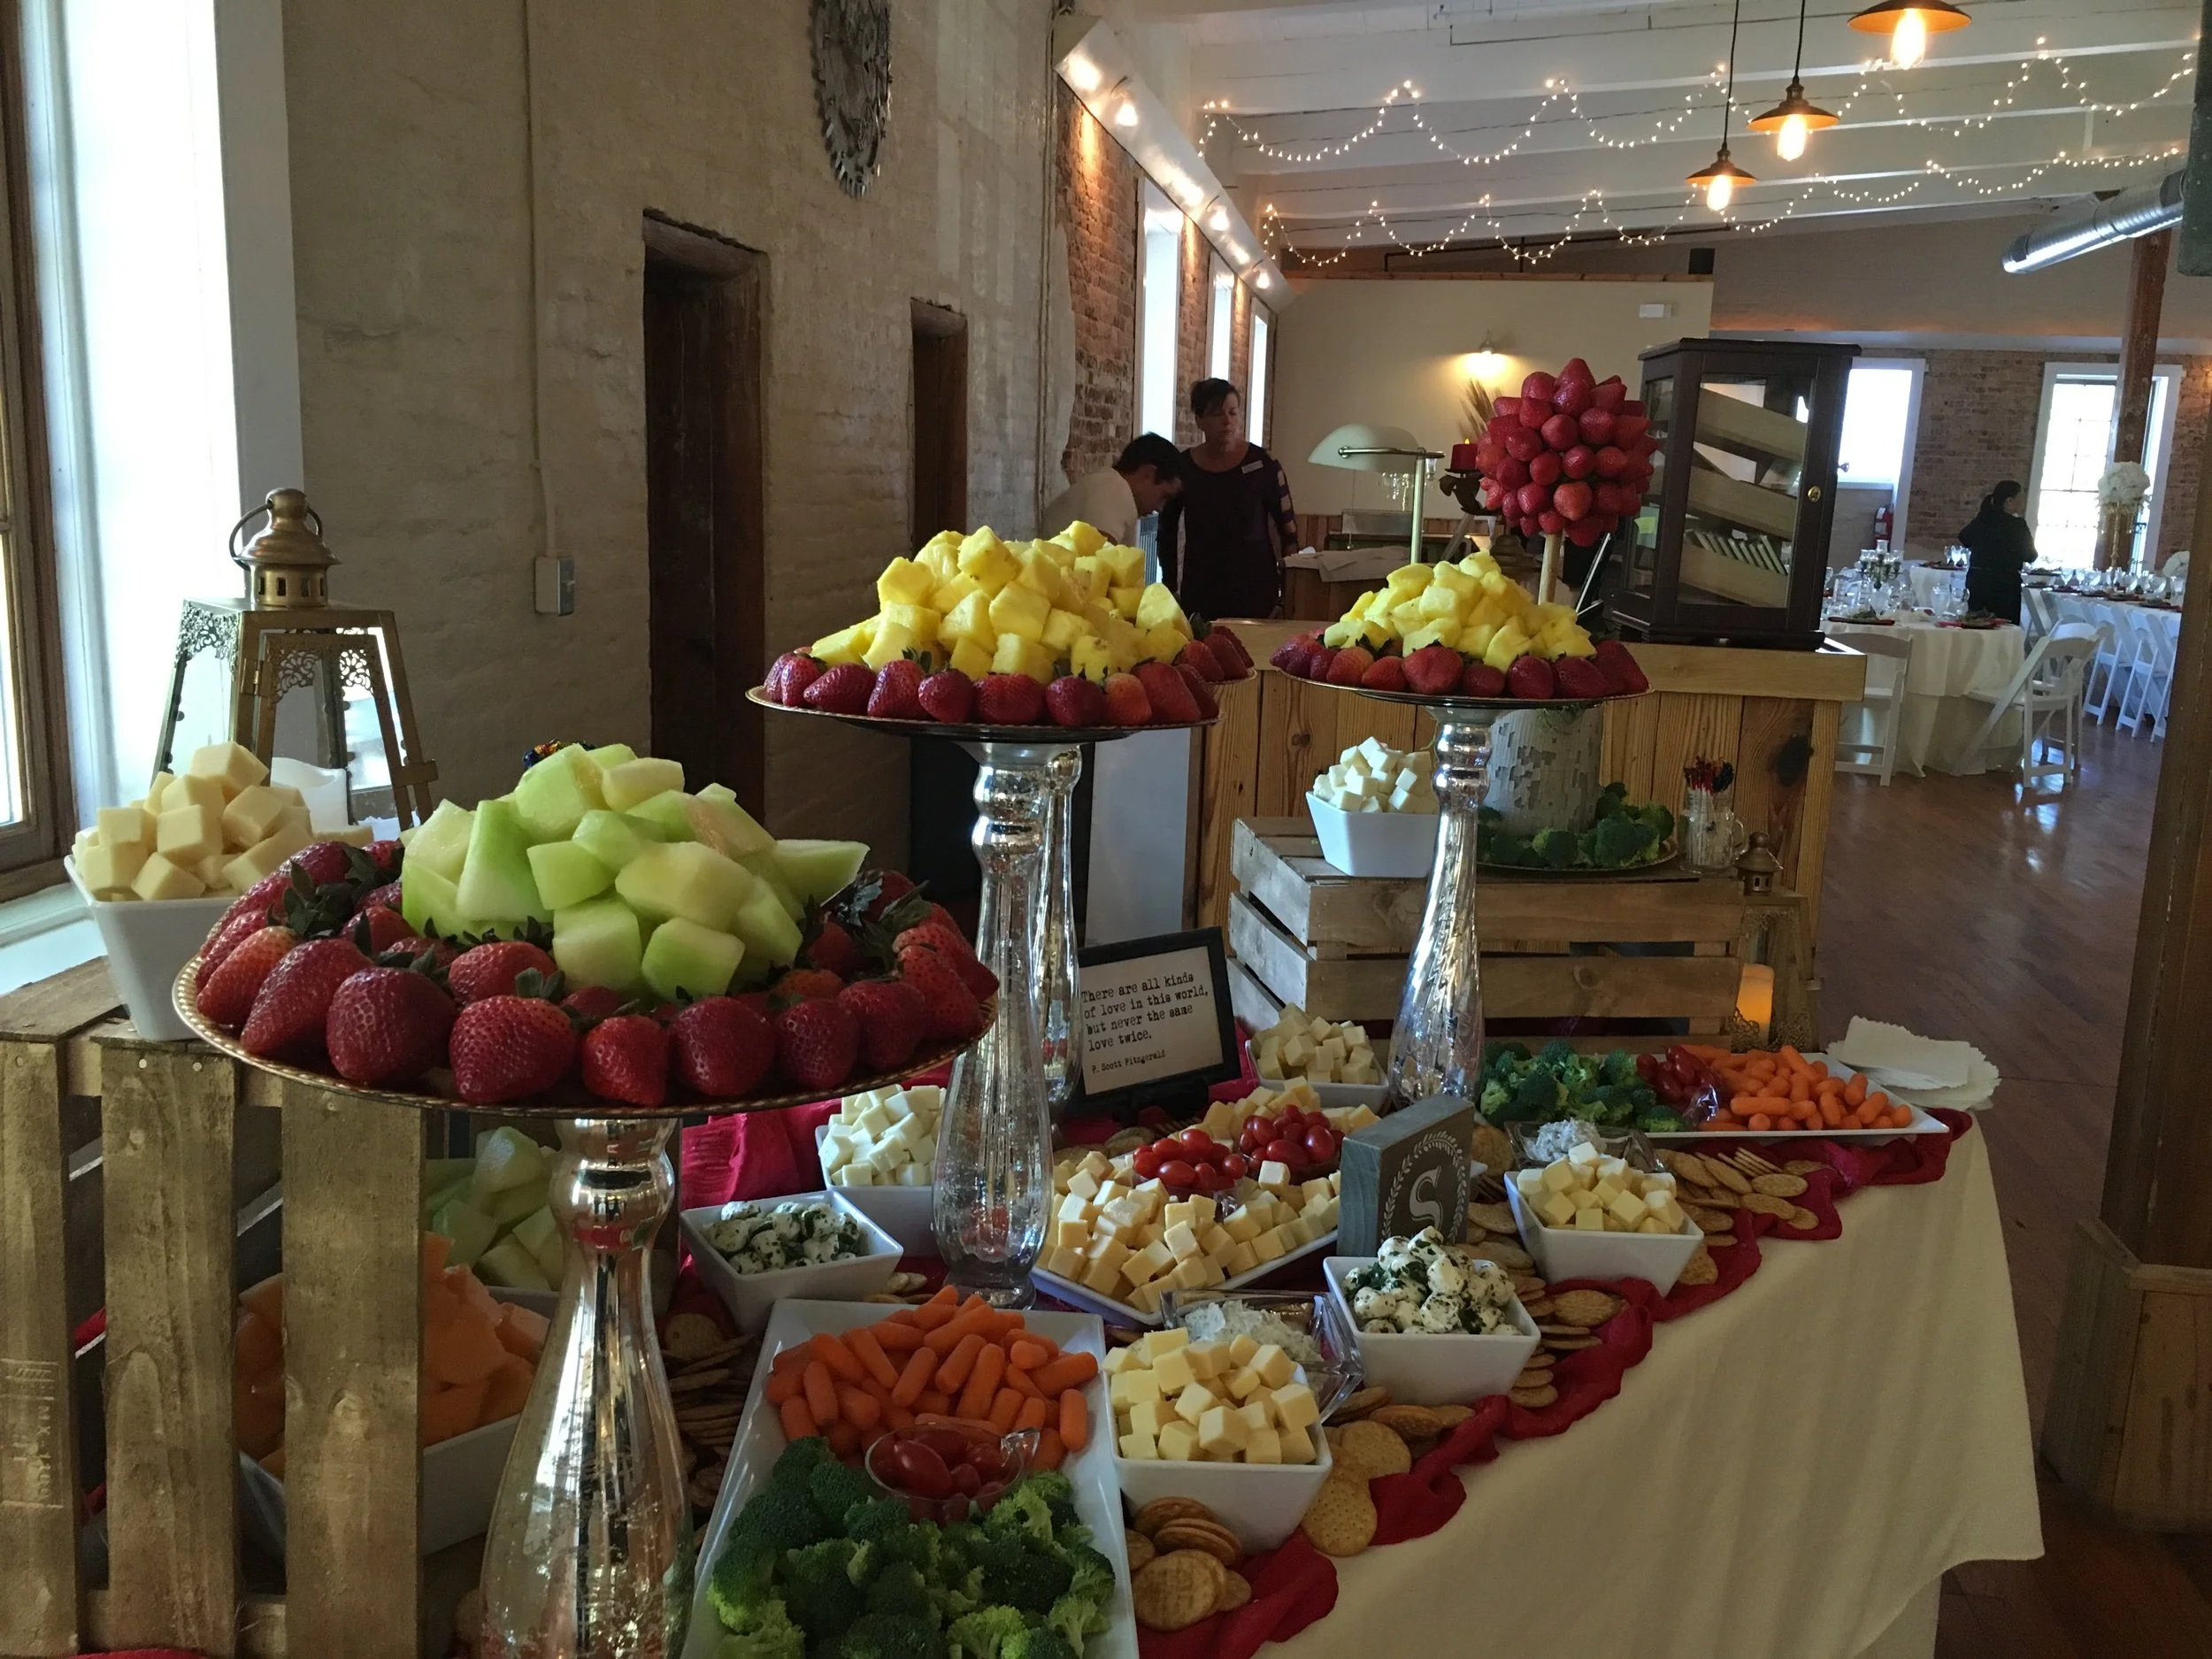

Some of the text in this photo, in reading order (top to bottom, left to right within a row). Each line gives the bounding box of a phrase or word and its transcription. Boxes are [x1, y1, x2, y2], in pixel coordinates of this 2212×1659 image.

[1081, 972, 1194, 1002] There are all kinds
[1084, 985, 1208, 1018] of love in this world,
[1086, 1005, 1193, 1035] but never the same
[1088, 1030, 1152, 1052] love twice.
[1101, 1061, 1122, 1071] Scott
[1409, 1164, 1444, 1231] S
